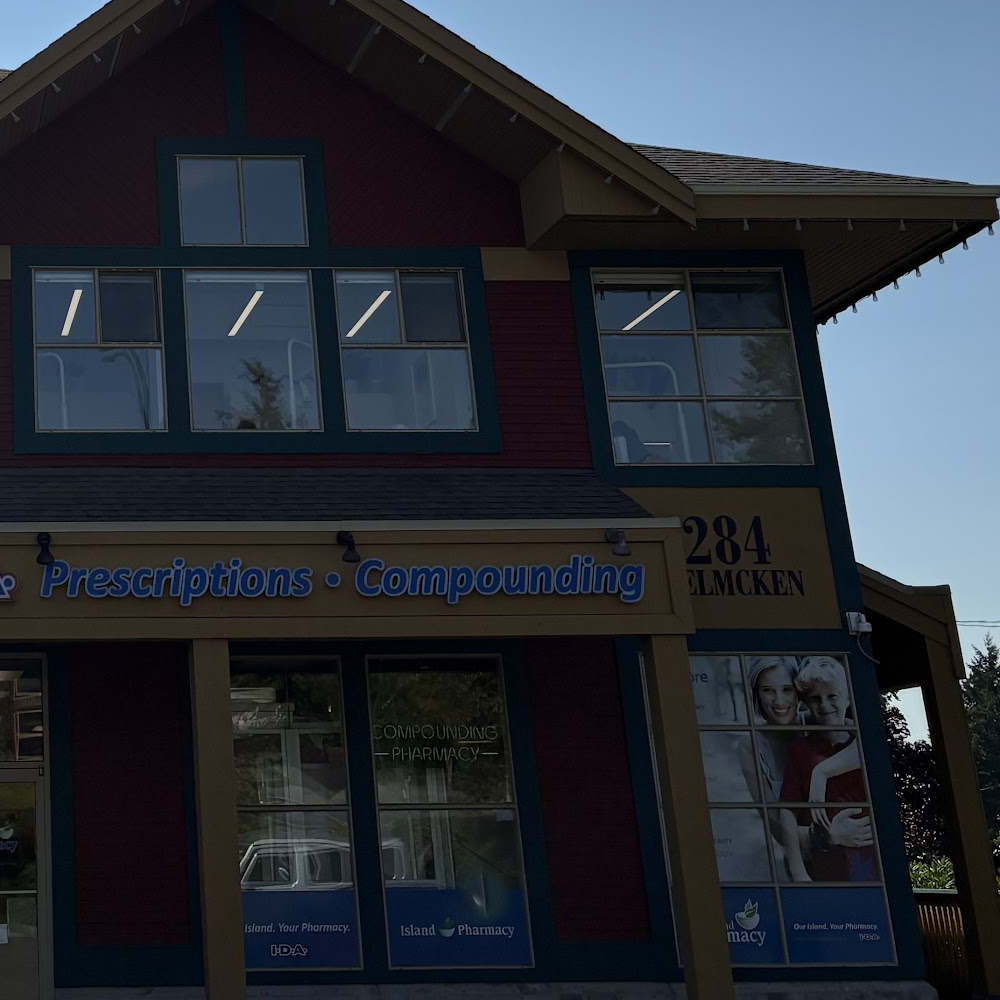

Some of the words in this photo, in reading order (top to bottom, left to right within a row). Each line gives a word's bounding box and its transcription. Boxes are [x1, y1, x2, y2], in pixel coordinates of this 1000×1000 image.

[683, 515, 771, 564] 284
[40, 557, 313, 607] Prescriptions
[354, 555, 645, 604] Compounding
[373, 724, 498, 740] COMPOUNDING
[392, 747, 480, 762] PHARMACY
[244, 923, 276, 933] Island.
[278, 923, 299, 933] Your
[301, 922, 351, 934] Pharmacy.
[400, 924, 436, 937] Island
[457, 924, 515, 938] Pharmacy
[830, 922, 844, 930] Your
